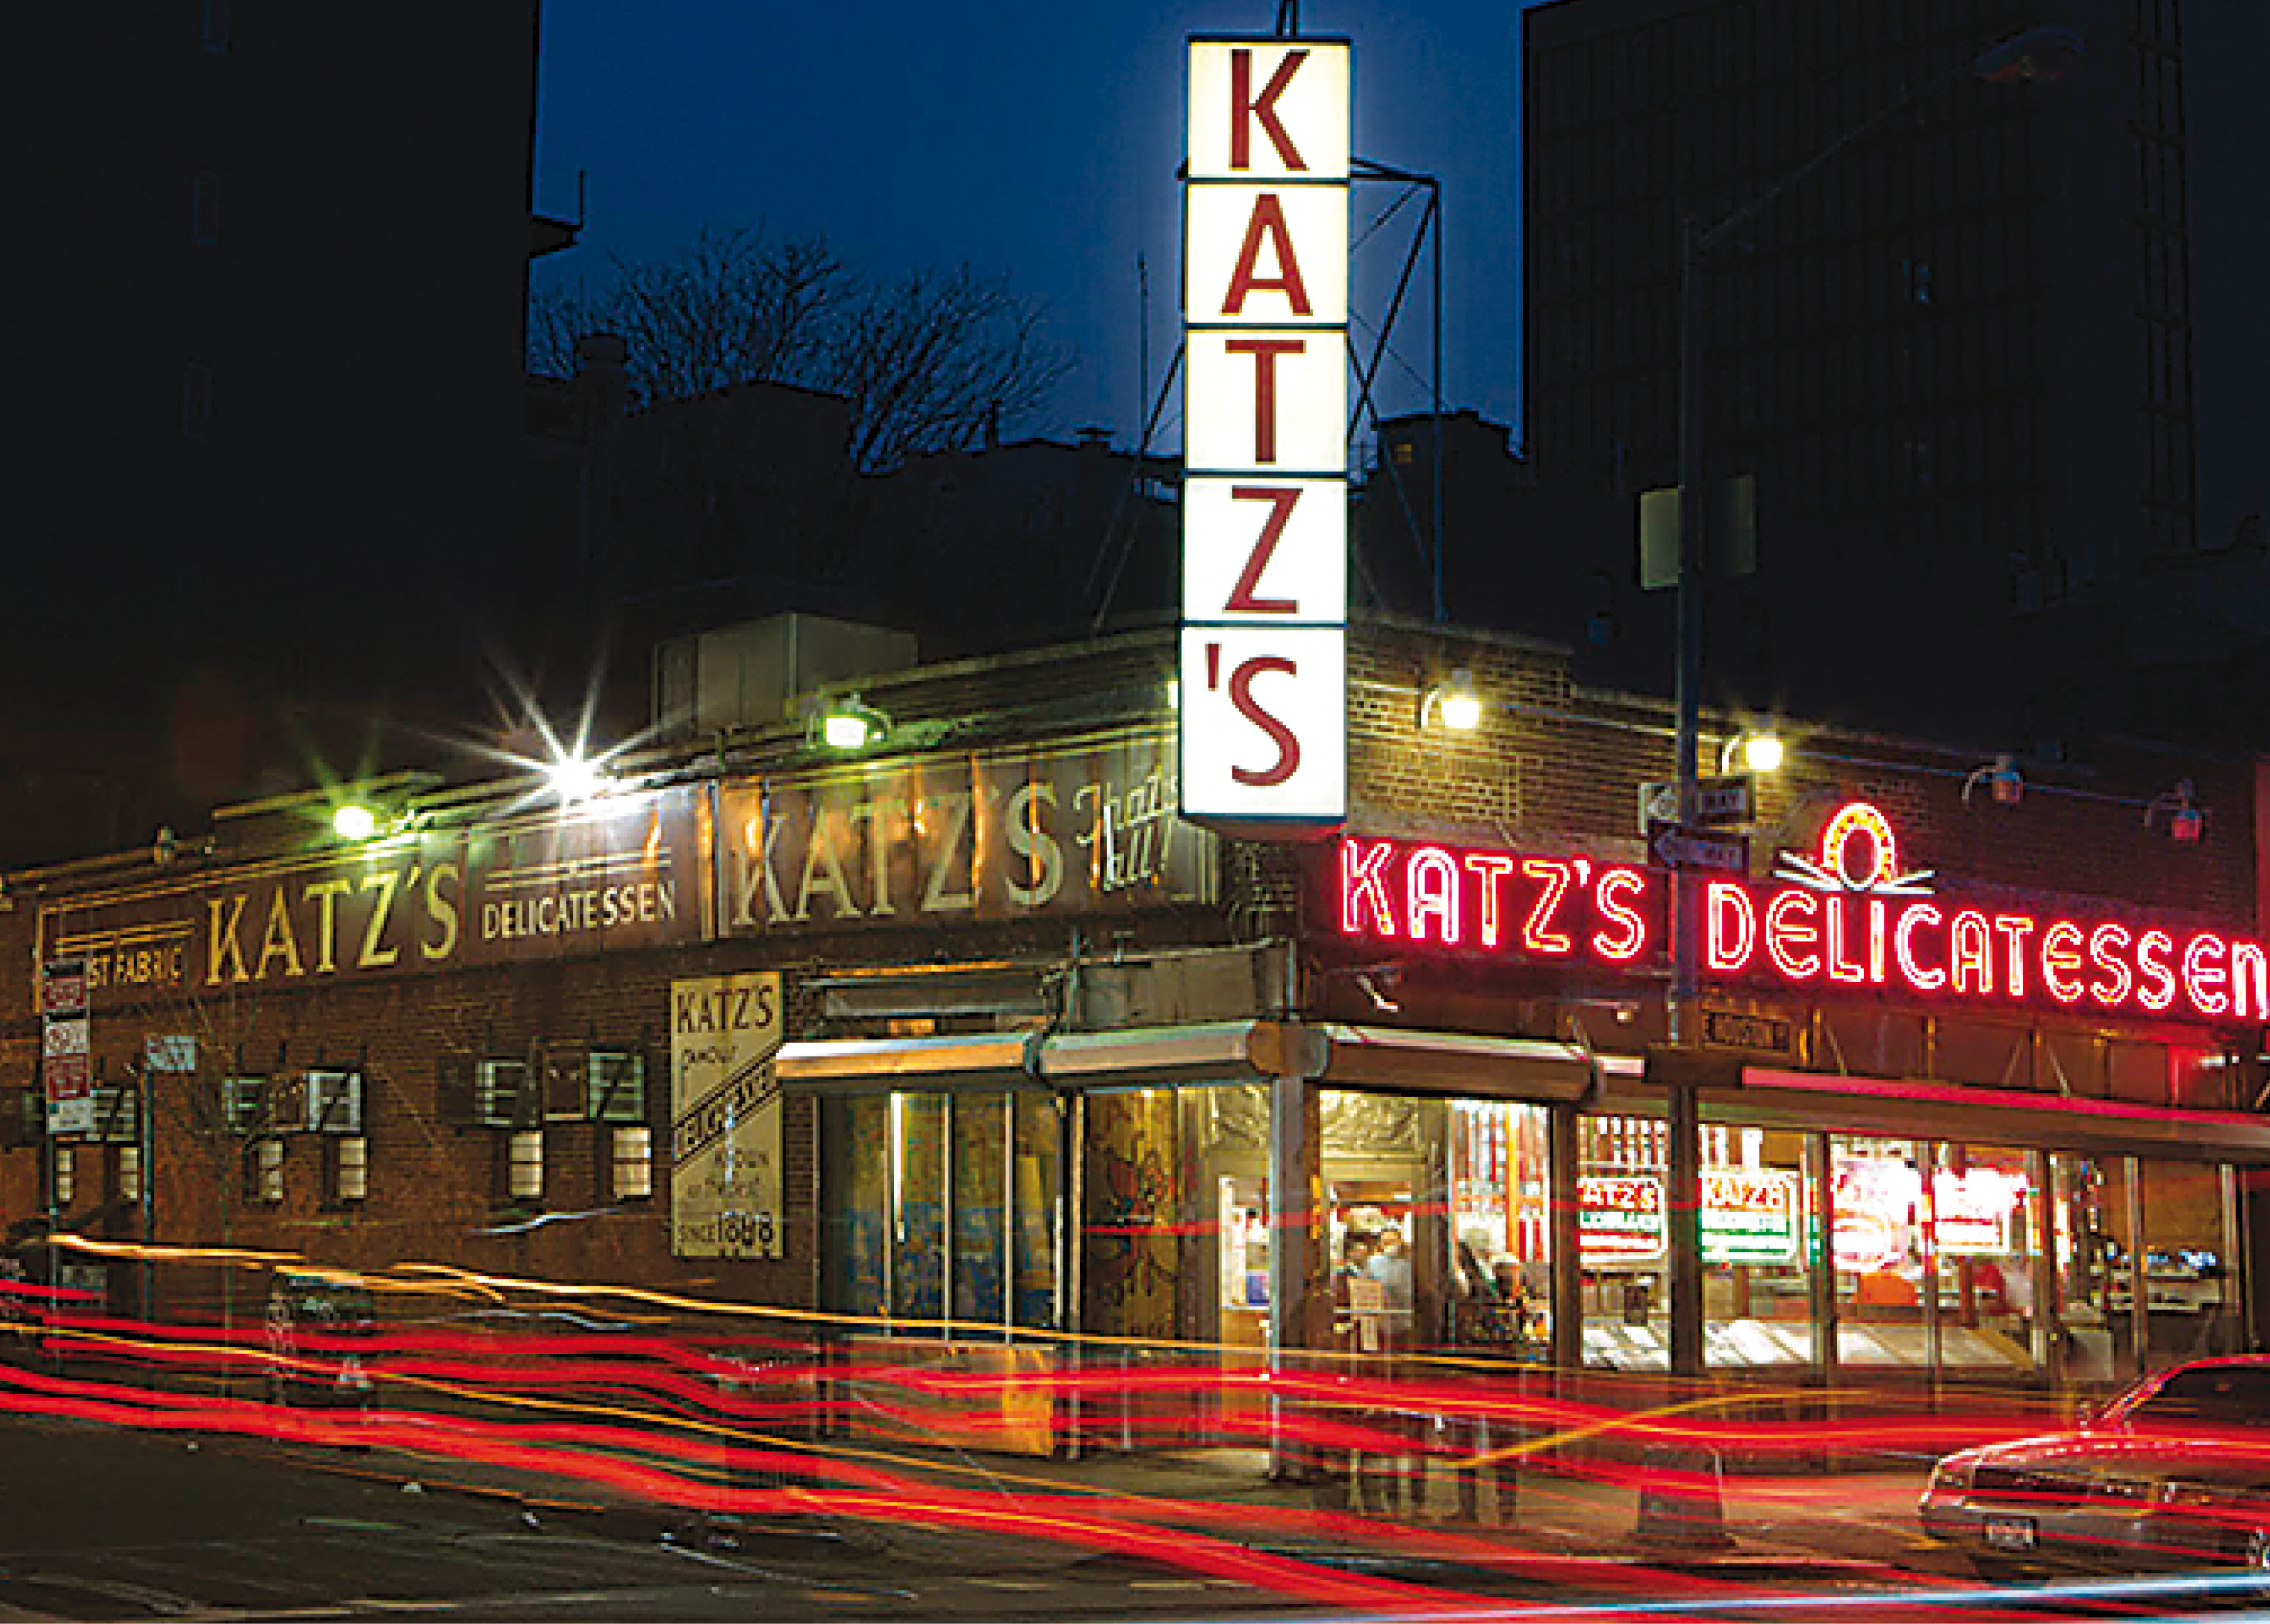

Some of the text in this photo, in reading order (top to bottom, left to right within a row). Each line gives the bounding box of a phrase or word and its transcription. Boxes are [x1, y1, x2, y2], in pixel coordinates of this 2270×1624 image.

[1205, 47, 1313, 788] KATZ'S
[204, 862, 460, 986] KATZ'S
[481, 880, 676, 939] DELICATESSEN
[731, 781, 1063, 926] KATZ'S
[1343, 836, 2270, 1021] KATZ'S DELICATESSEN
